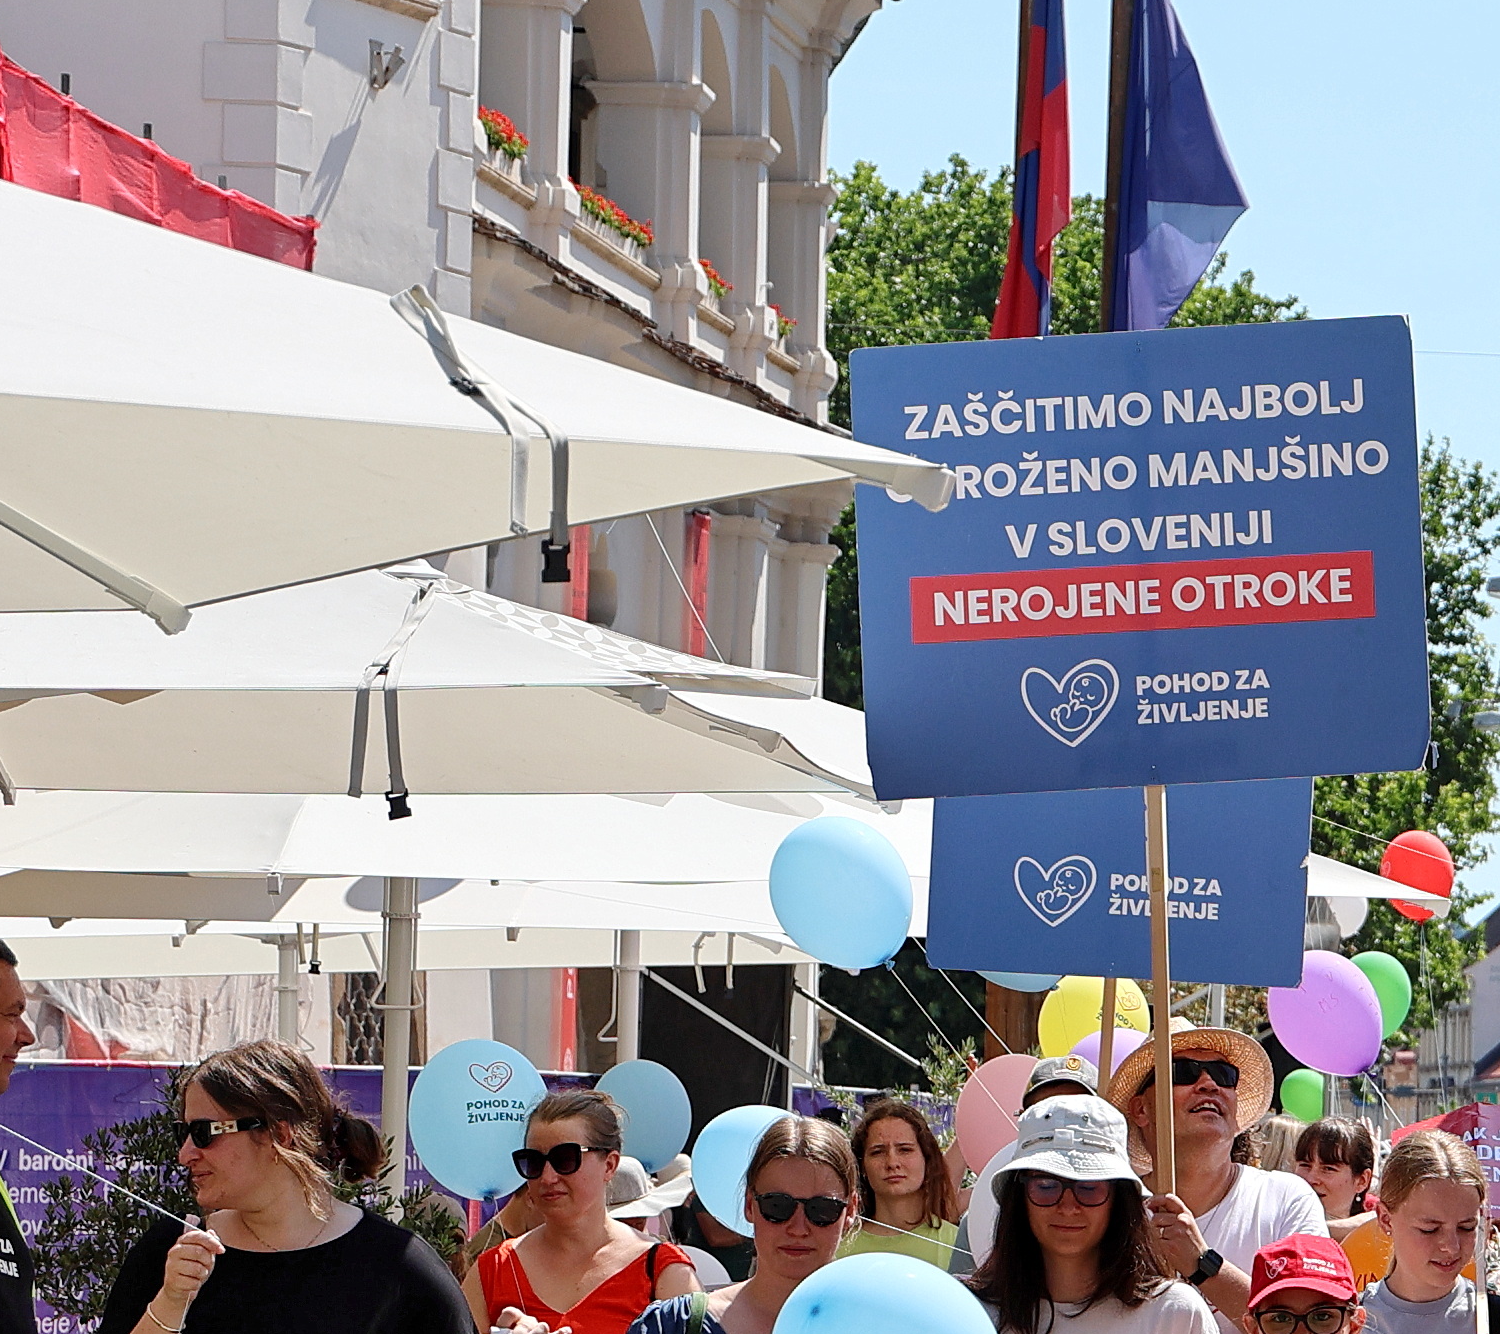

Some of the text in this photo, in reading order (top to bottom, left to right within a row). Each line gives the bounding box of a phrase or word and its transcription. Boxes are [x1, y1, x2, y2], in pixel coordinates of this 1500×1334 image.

[904, 378, 1365, 441] ZAŠČITIMO NAJBOLJ
[886, 435, 1390, 503] ROŽENO MANJŠINO
[1005, 509, 1273, 558] V SLOVENIJI
[934, 568, 1354, 626] NEROJENE OTROKE
[1136, 669, 1270, 695] POHOD ZA
[1136, 694, 1269, 725] ŽIVLJENJE
[1193, 878, 1222, 896] ZA
[1108, 893, 1219, 920] ŽIVLENJE
[467, 1099, 525, 1111] POHOD ZA
[468, 1111, 524, 1124] ŽIVLJENJE
[18, 1149, 94, 1172] baročni
